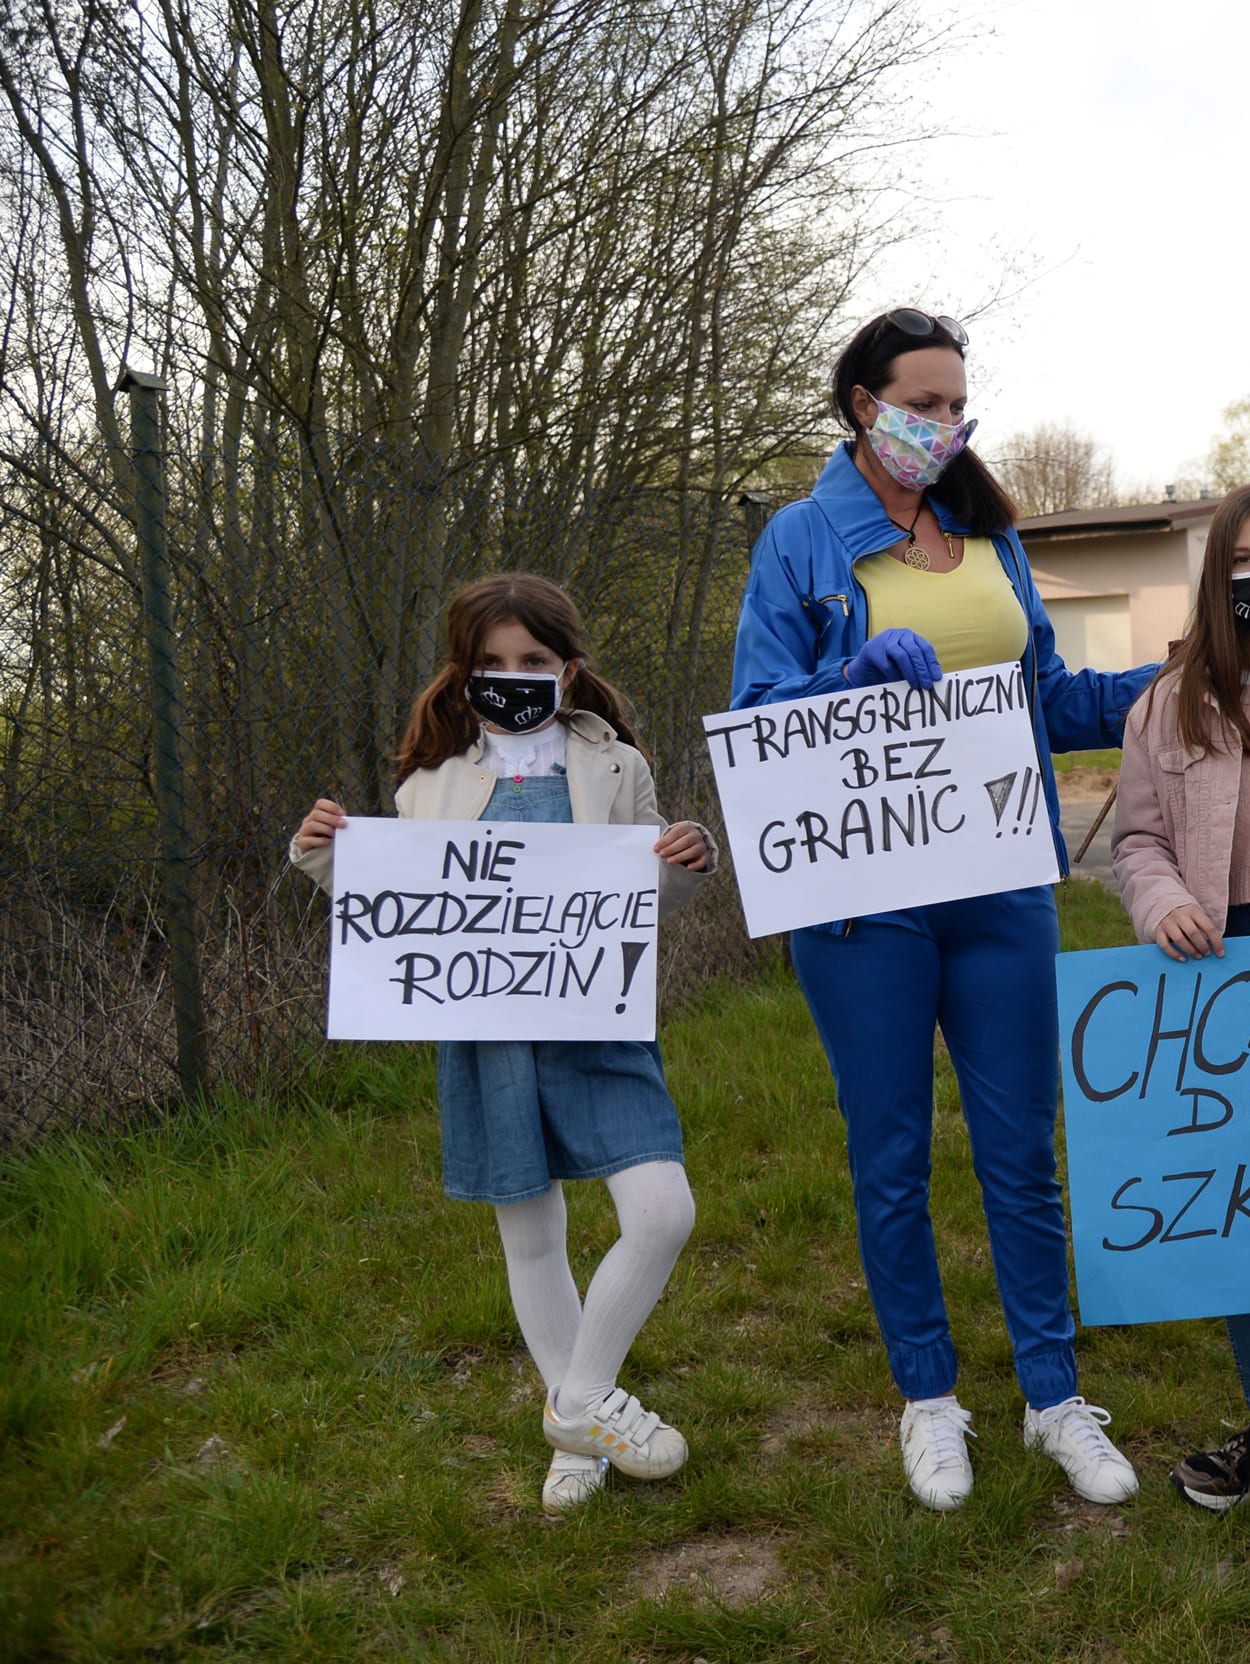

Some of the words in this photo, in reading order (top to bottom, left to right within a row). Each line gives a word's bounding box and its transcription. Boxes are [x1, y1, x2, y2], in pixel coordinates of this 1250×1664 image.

[705, 663, 1026, 768] TRANSGRANICZNI
[840, 737, 952, 789] BEZ
[441, 829, 525, 882] NIE
[334, 887, 658, 949] ROZDZIELAJCIE
